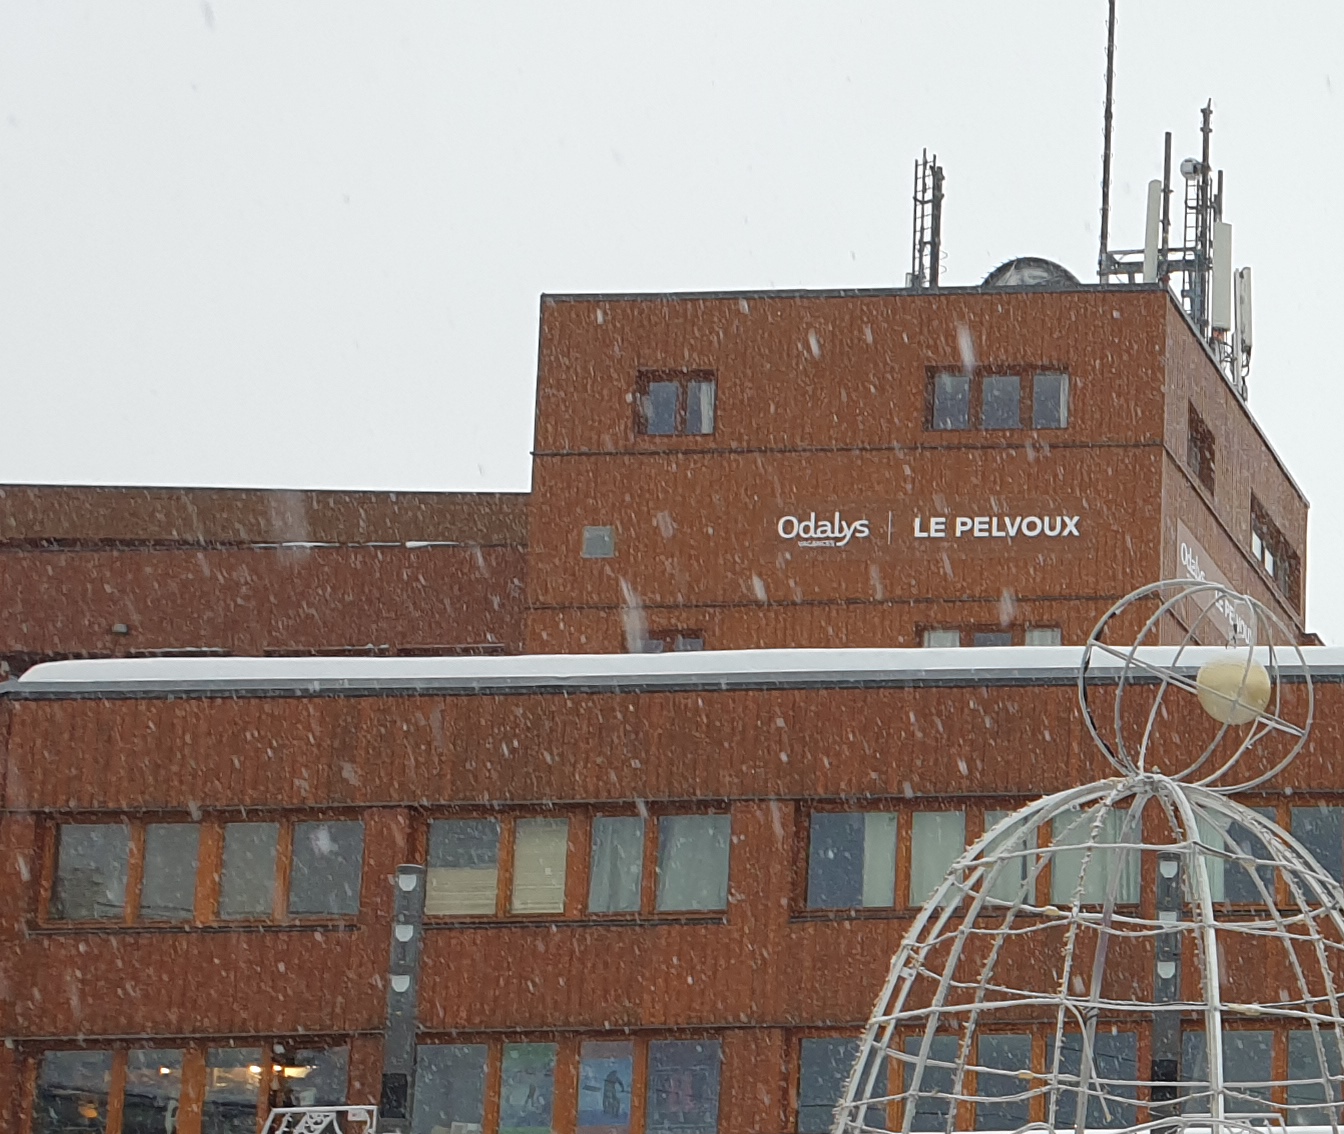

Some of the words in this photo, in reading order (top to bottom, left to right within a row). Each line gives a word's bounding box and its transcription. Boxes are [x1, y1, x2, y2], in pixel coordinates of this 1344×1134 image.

[778, 512, 870, 546] Odalys
[914, 517, 946, 538] LE
[955, 515, 1080, 537] PELVOUX
